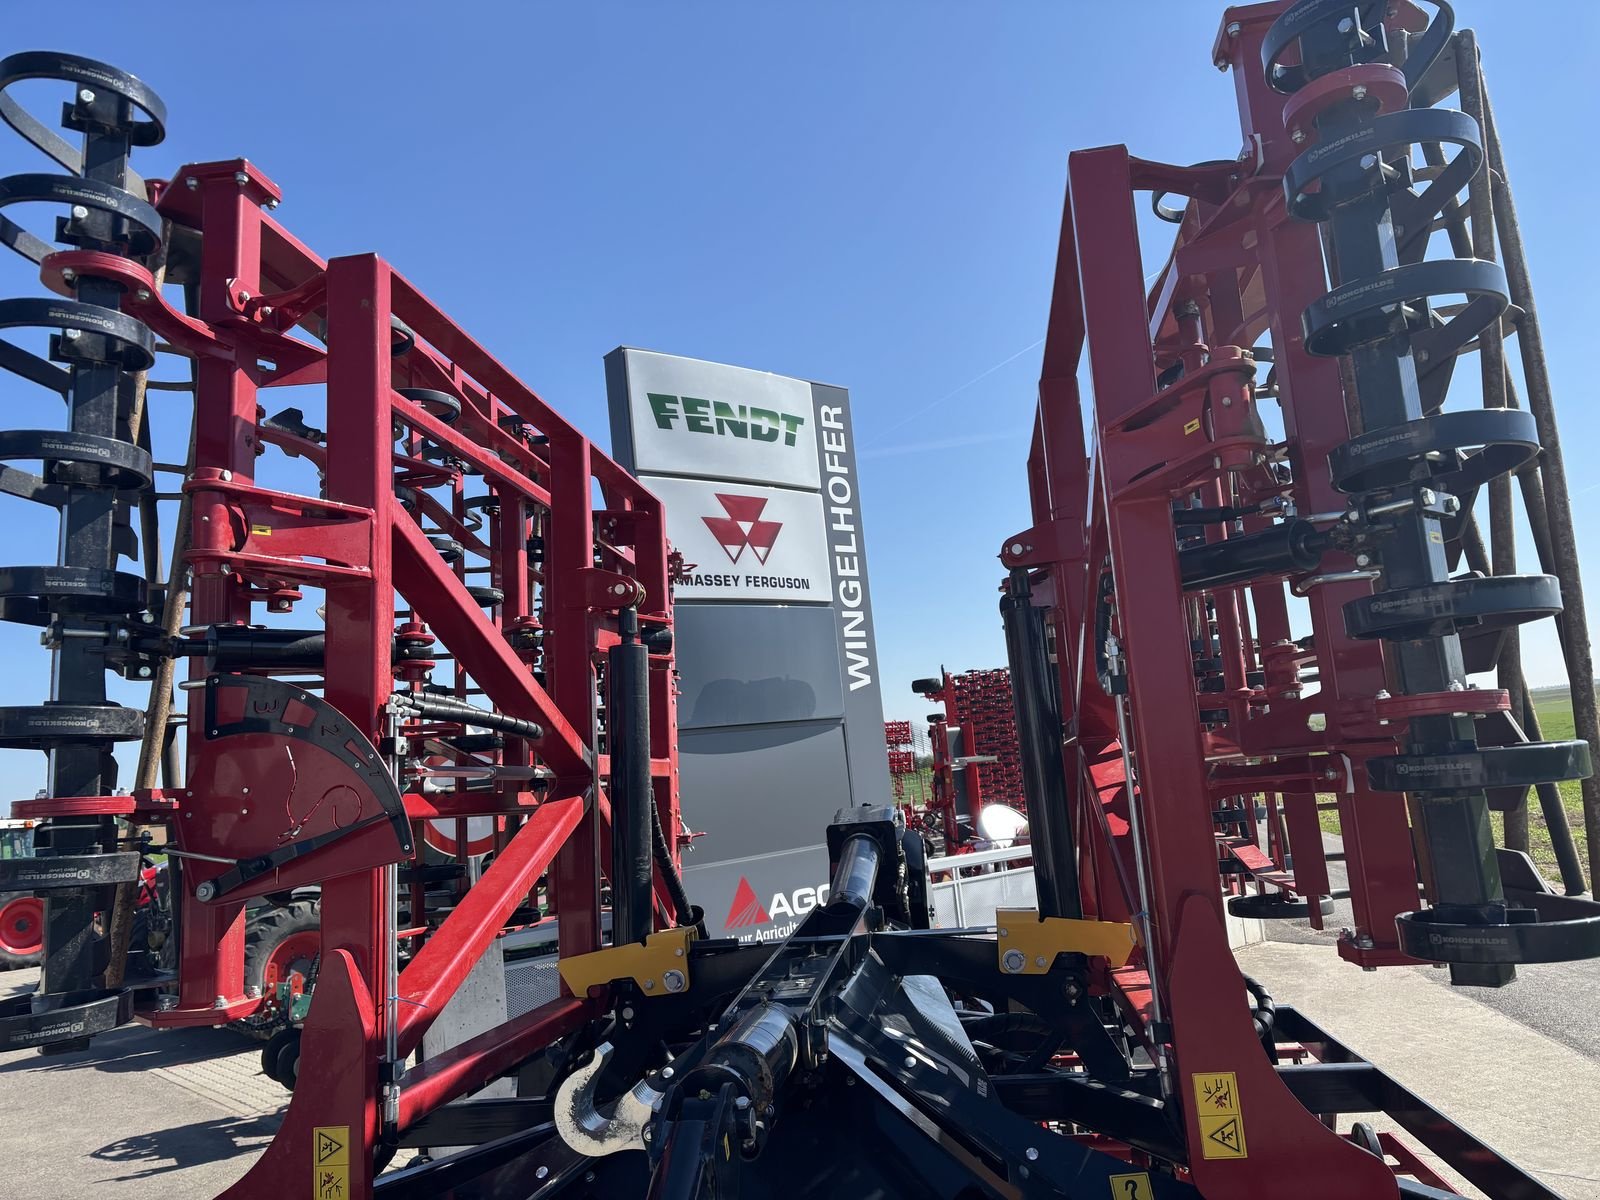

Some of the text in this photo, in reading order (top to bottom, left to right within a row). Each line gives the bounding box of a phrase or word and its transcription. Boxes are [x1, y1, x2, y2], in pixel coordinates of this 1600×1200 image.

[1318, 127, 1375, 153] KONGSKILDE
[1337, 278, 1395, 300] KONGSKILDE
[48, 310, 104, 325] KONGSKILDE
[646, 392, 805, 448] FENDT
[1361, 431, 1421, 449] KONGSKILDE
[41, 442, 98, 454] KONGSKILDE
[820, 404, 871, 692] WINGELHOFER
[679, 574, 810, 590] MASSEY FERGUSON
[1408, 763, 1473, 772] KONGSKILDE
[17, 872, 77, 881] KONGSKILDE
[1442, 937, 1509, 945] KONGSKILDE
[10, 1026, 72, 1041] KONGSKILDE
